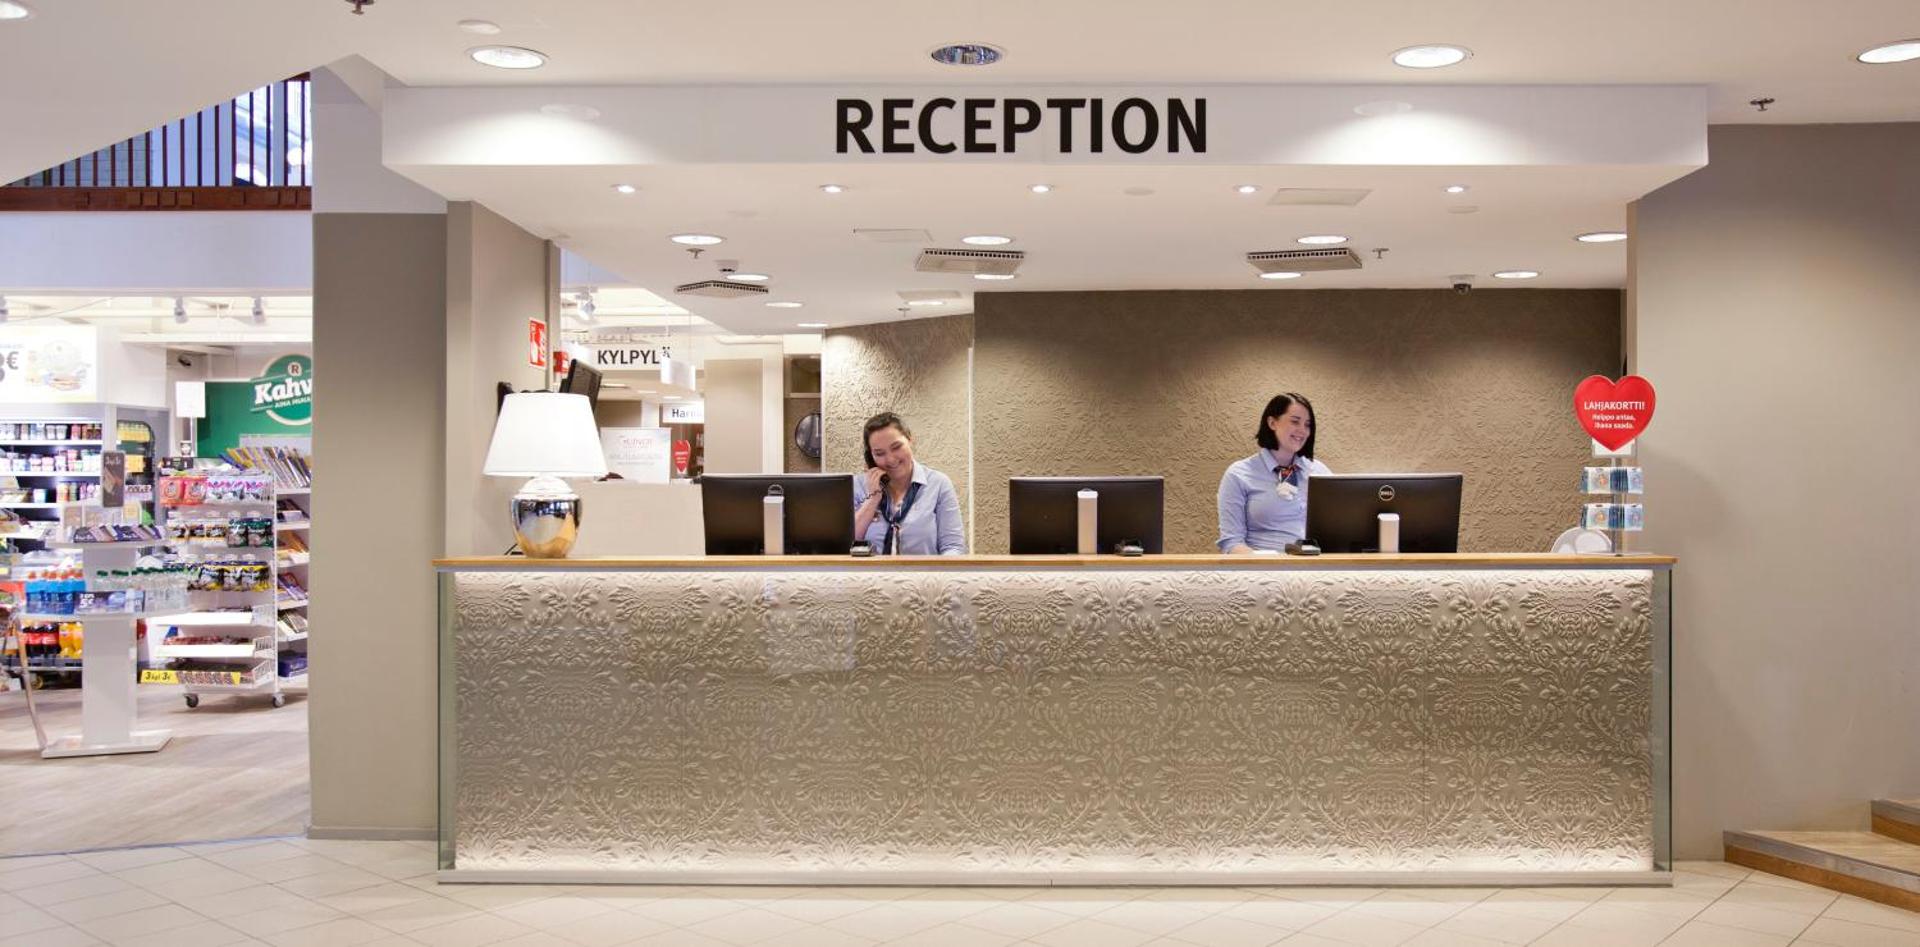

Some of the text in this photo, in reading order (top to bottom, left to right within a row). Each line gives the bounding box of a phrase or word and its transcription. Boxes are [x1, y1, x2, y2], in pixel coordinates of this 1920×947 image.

[836, 97, 1207, 154] RECEPTION
[291, 365, 299, 374] R
[1583, 401, 1646, 411] LAHJAKORTTI!
